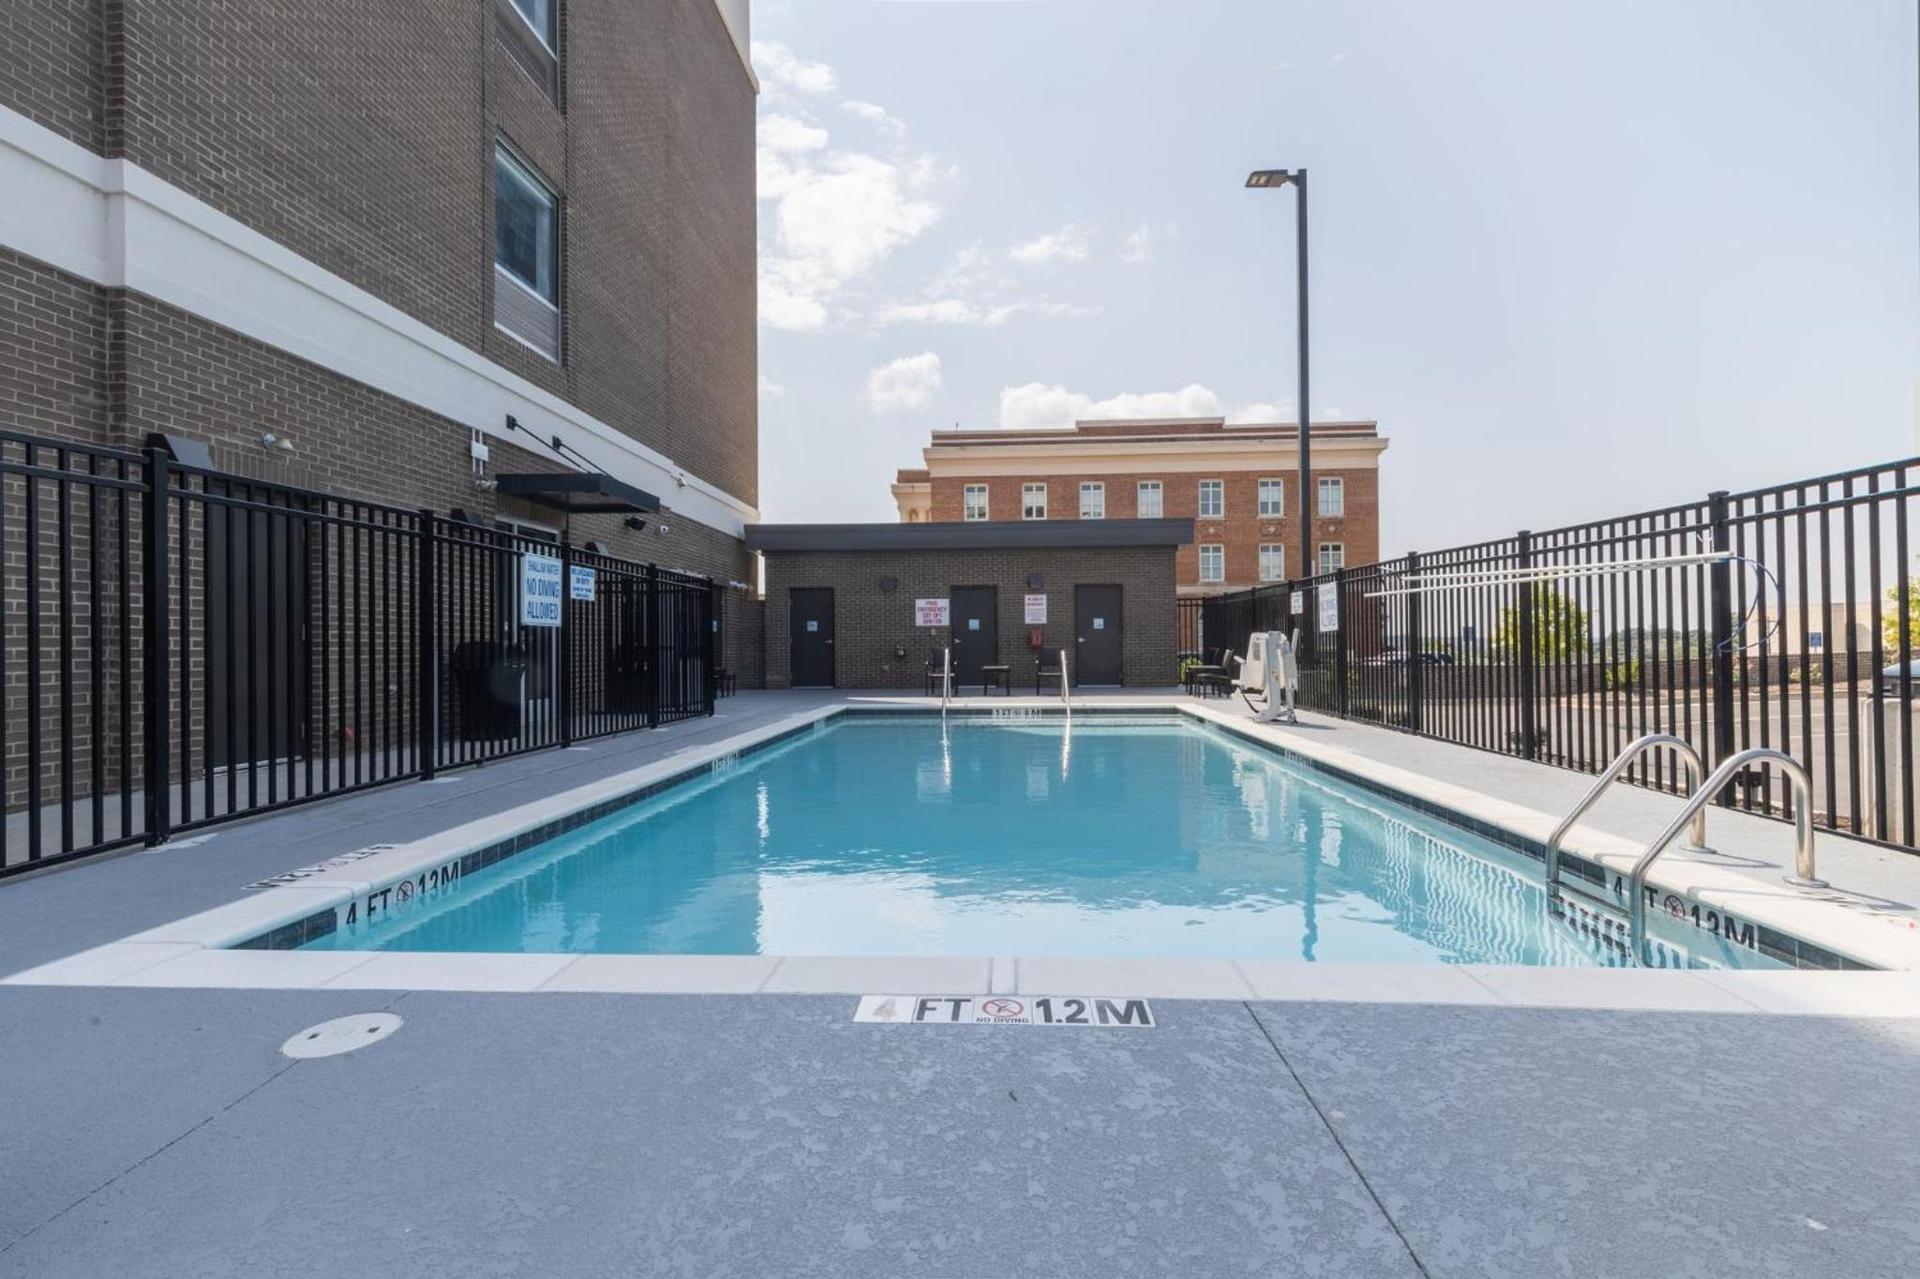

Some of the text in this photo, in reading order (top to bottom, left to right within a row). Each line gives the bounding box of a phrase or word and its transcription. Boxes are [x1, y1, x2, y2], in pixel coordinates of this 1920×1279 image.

[527, 576, 560, 598] NO DIVING
[527, 600, 559, 619] ALLOWED
[367, 887, 392, 917] FT
[871, 998, 897, 1018] 4
[915, 998, 972, 1022] FT
